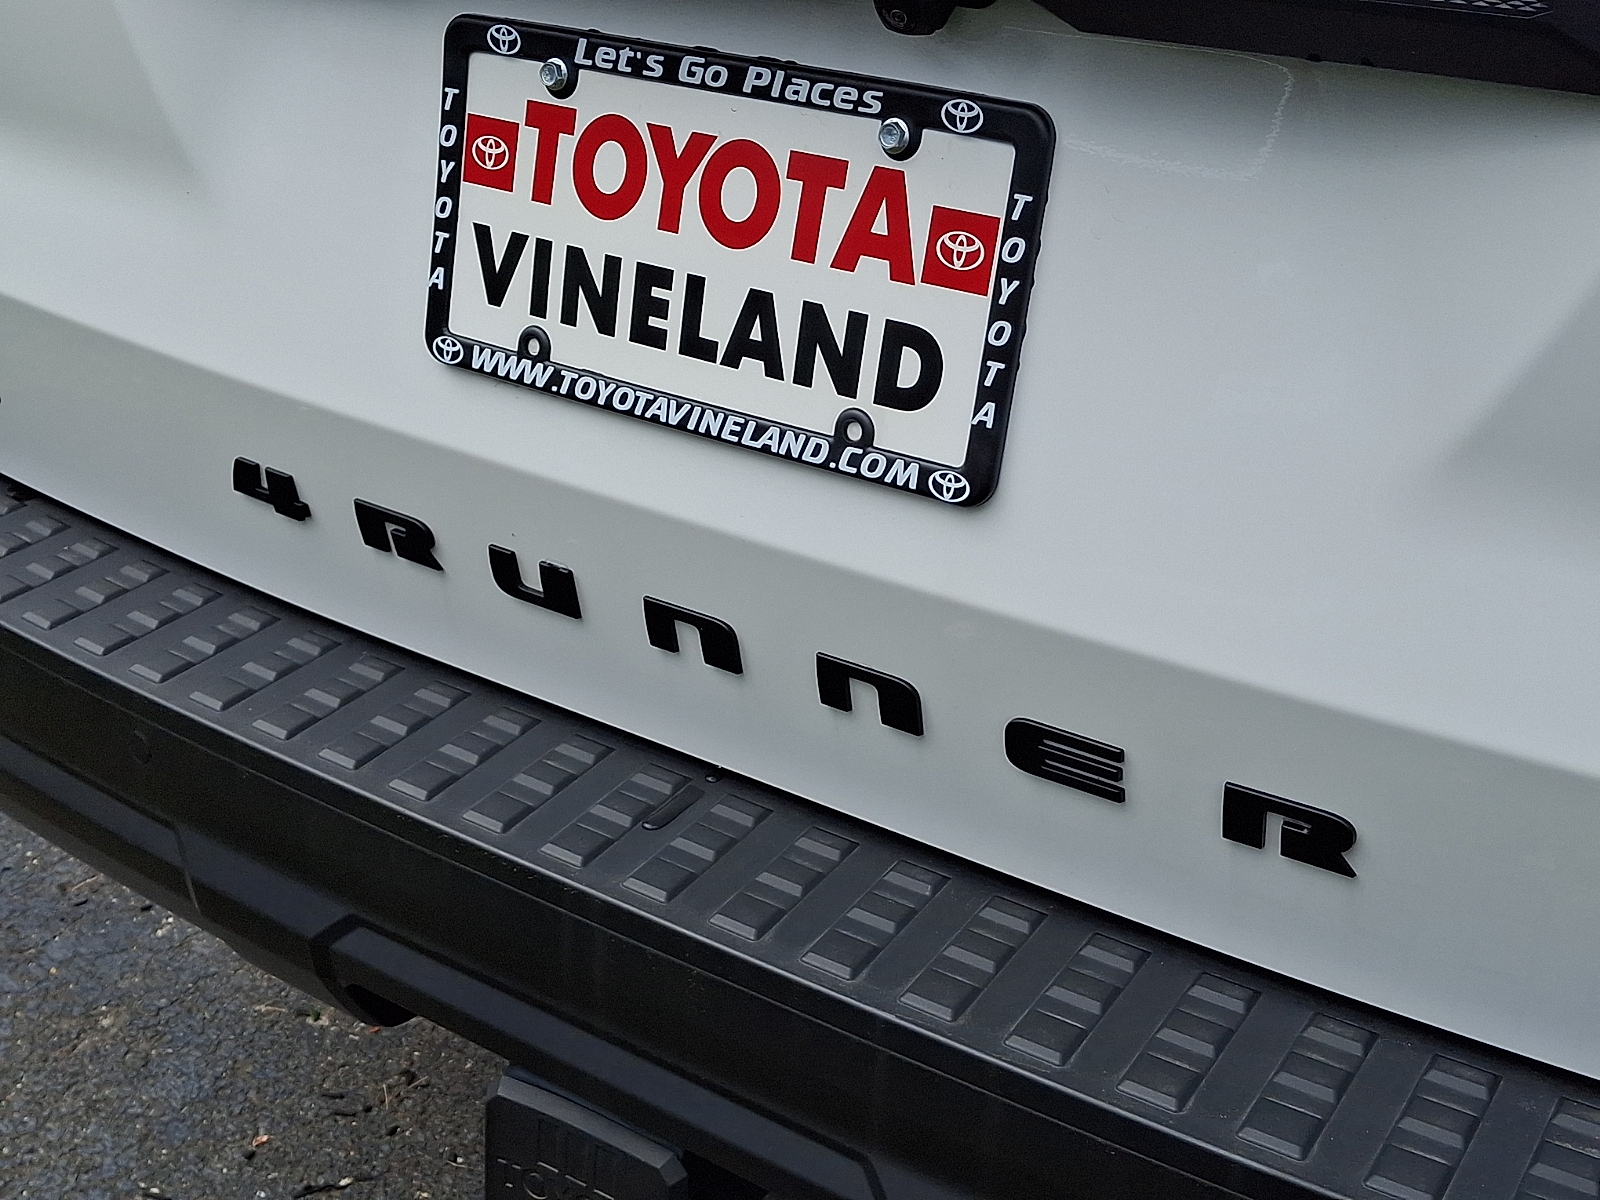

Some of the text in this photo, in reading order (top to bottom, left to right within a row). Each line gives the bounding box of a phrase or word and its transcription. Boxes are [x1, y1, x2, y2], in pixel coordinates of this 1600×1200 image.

[573, 37, 884, 115] Let's Go Places
[428, 87, 460, 290] TOYOTA
[525, 100, 916, 286] TOYOTA
[472, 221, 944, 413] VINELAND
[971, 193, 1034, 429] TOYOTA
[471, 344, 920, 491] WWW.TOYOTAVINELAND.COM
